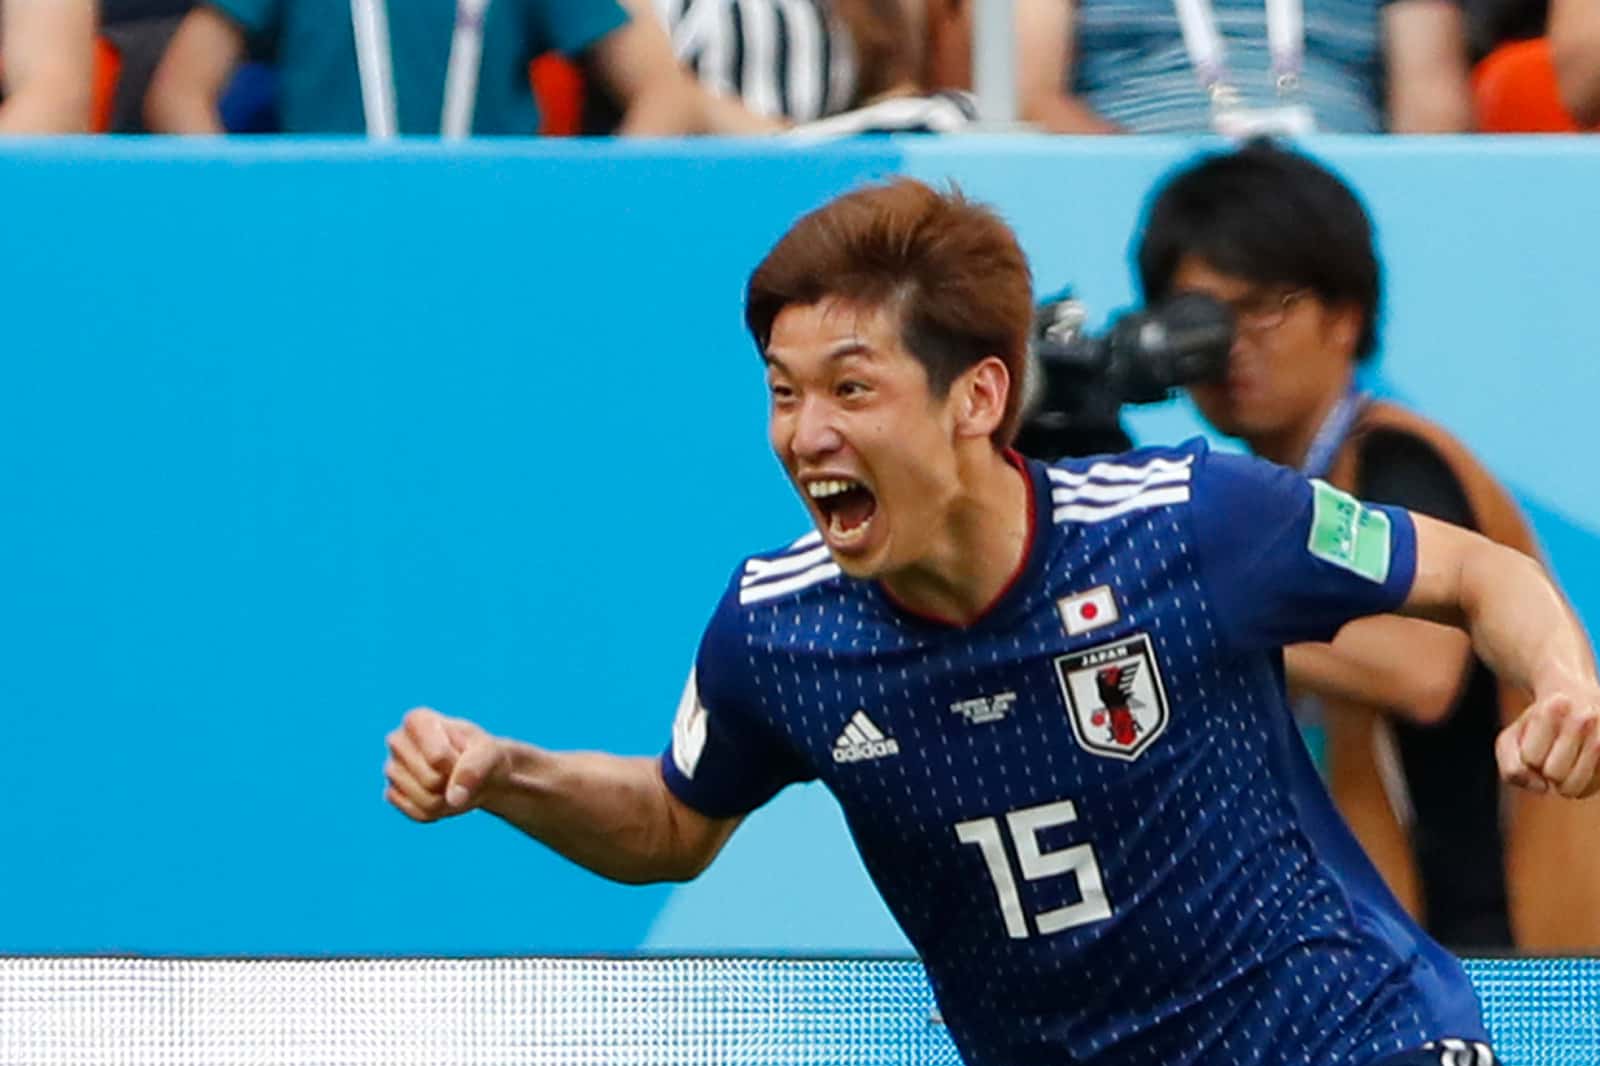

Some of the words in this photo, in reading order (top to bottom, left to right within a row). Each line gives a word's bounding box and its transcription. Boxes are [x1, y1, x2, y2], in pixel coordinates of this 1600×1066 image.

[1081, 645, 1128, 667] JAPAN
[832, 738, 899, 763] adidas
[954, 799, 1113, 939] 15
